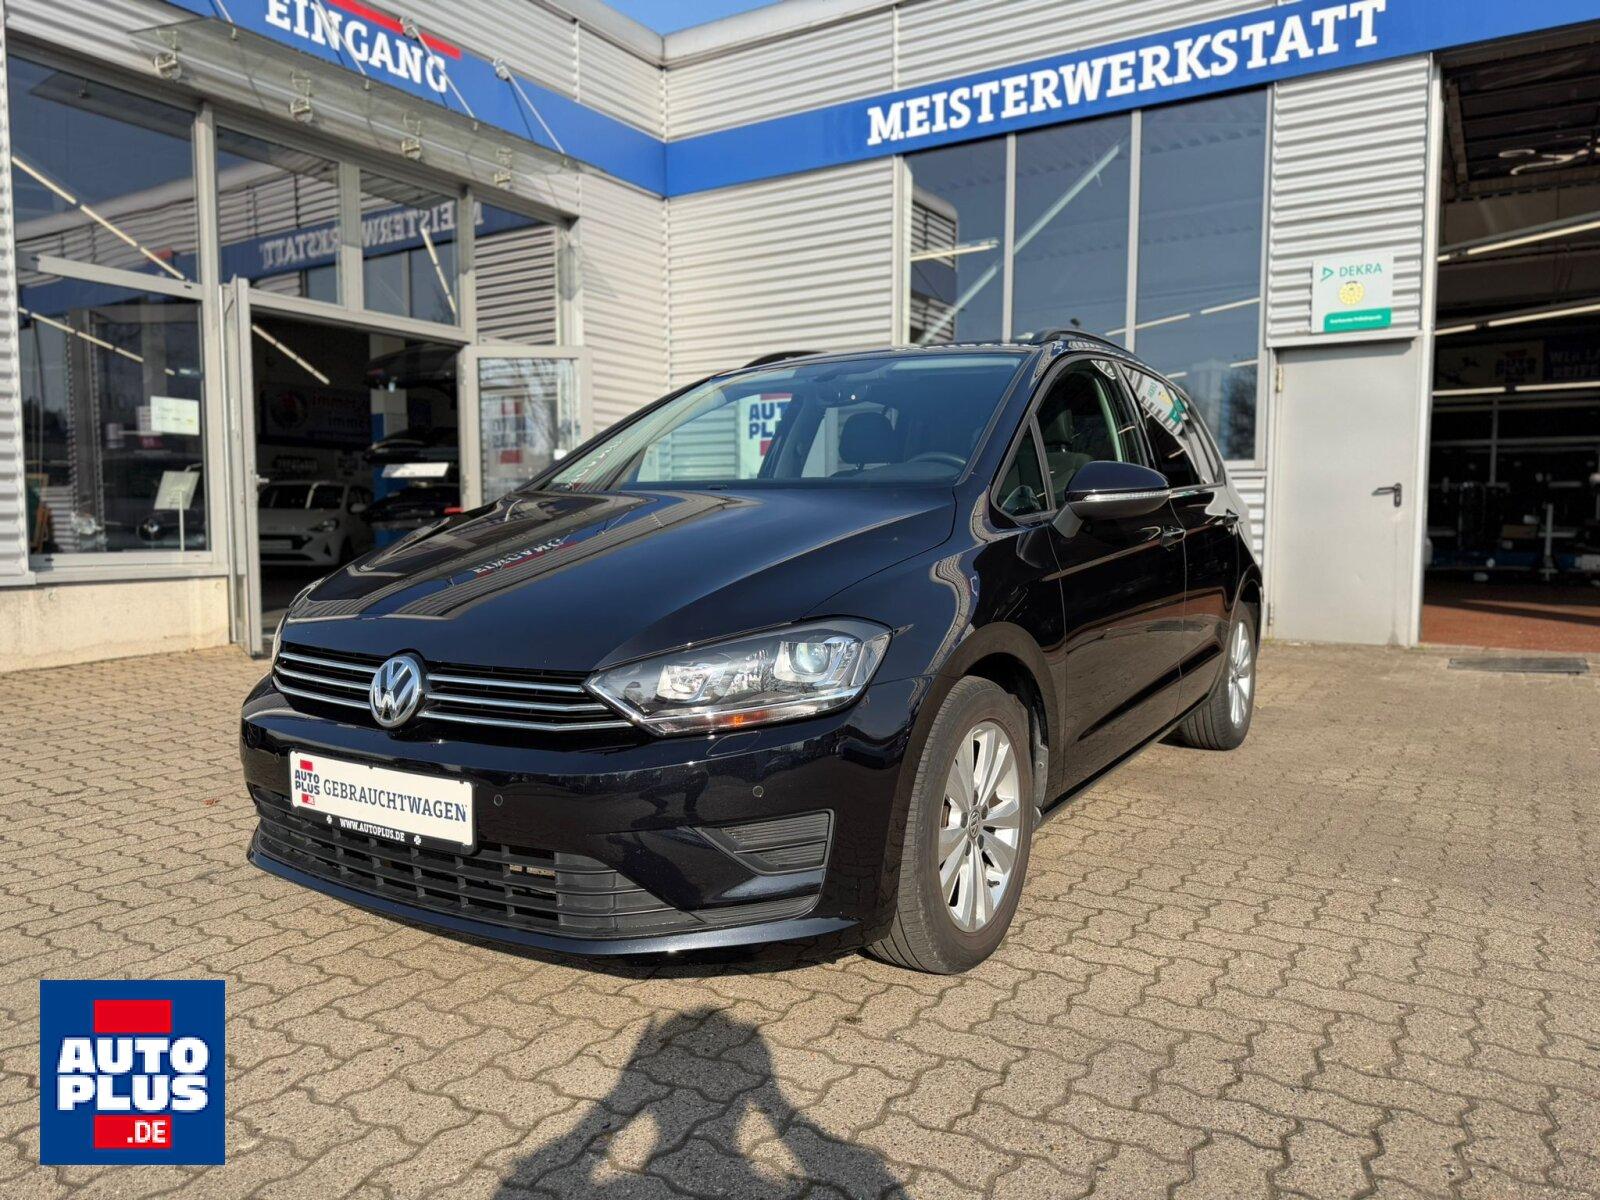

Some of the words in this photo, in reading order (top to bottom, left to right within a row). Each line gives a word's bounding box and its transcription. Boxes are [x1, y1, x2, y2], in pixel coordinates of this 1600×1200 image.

[265, 0, 447, 93] EINGANG
[867, 0, 1386, 146] MEISTERWERKSTATT
[1339, 263, 1383, 277] DEKRA
[749, 402, 790, 421] AUT
[294, 769, 320, 784] AUTO
[295, 780, 321, 795] PLUS
[323, 779, 467, 823] GEBRAUCHTWAGEN
[339, 818, 406, 842] WWW.AUTOPLUS.DE
